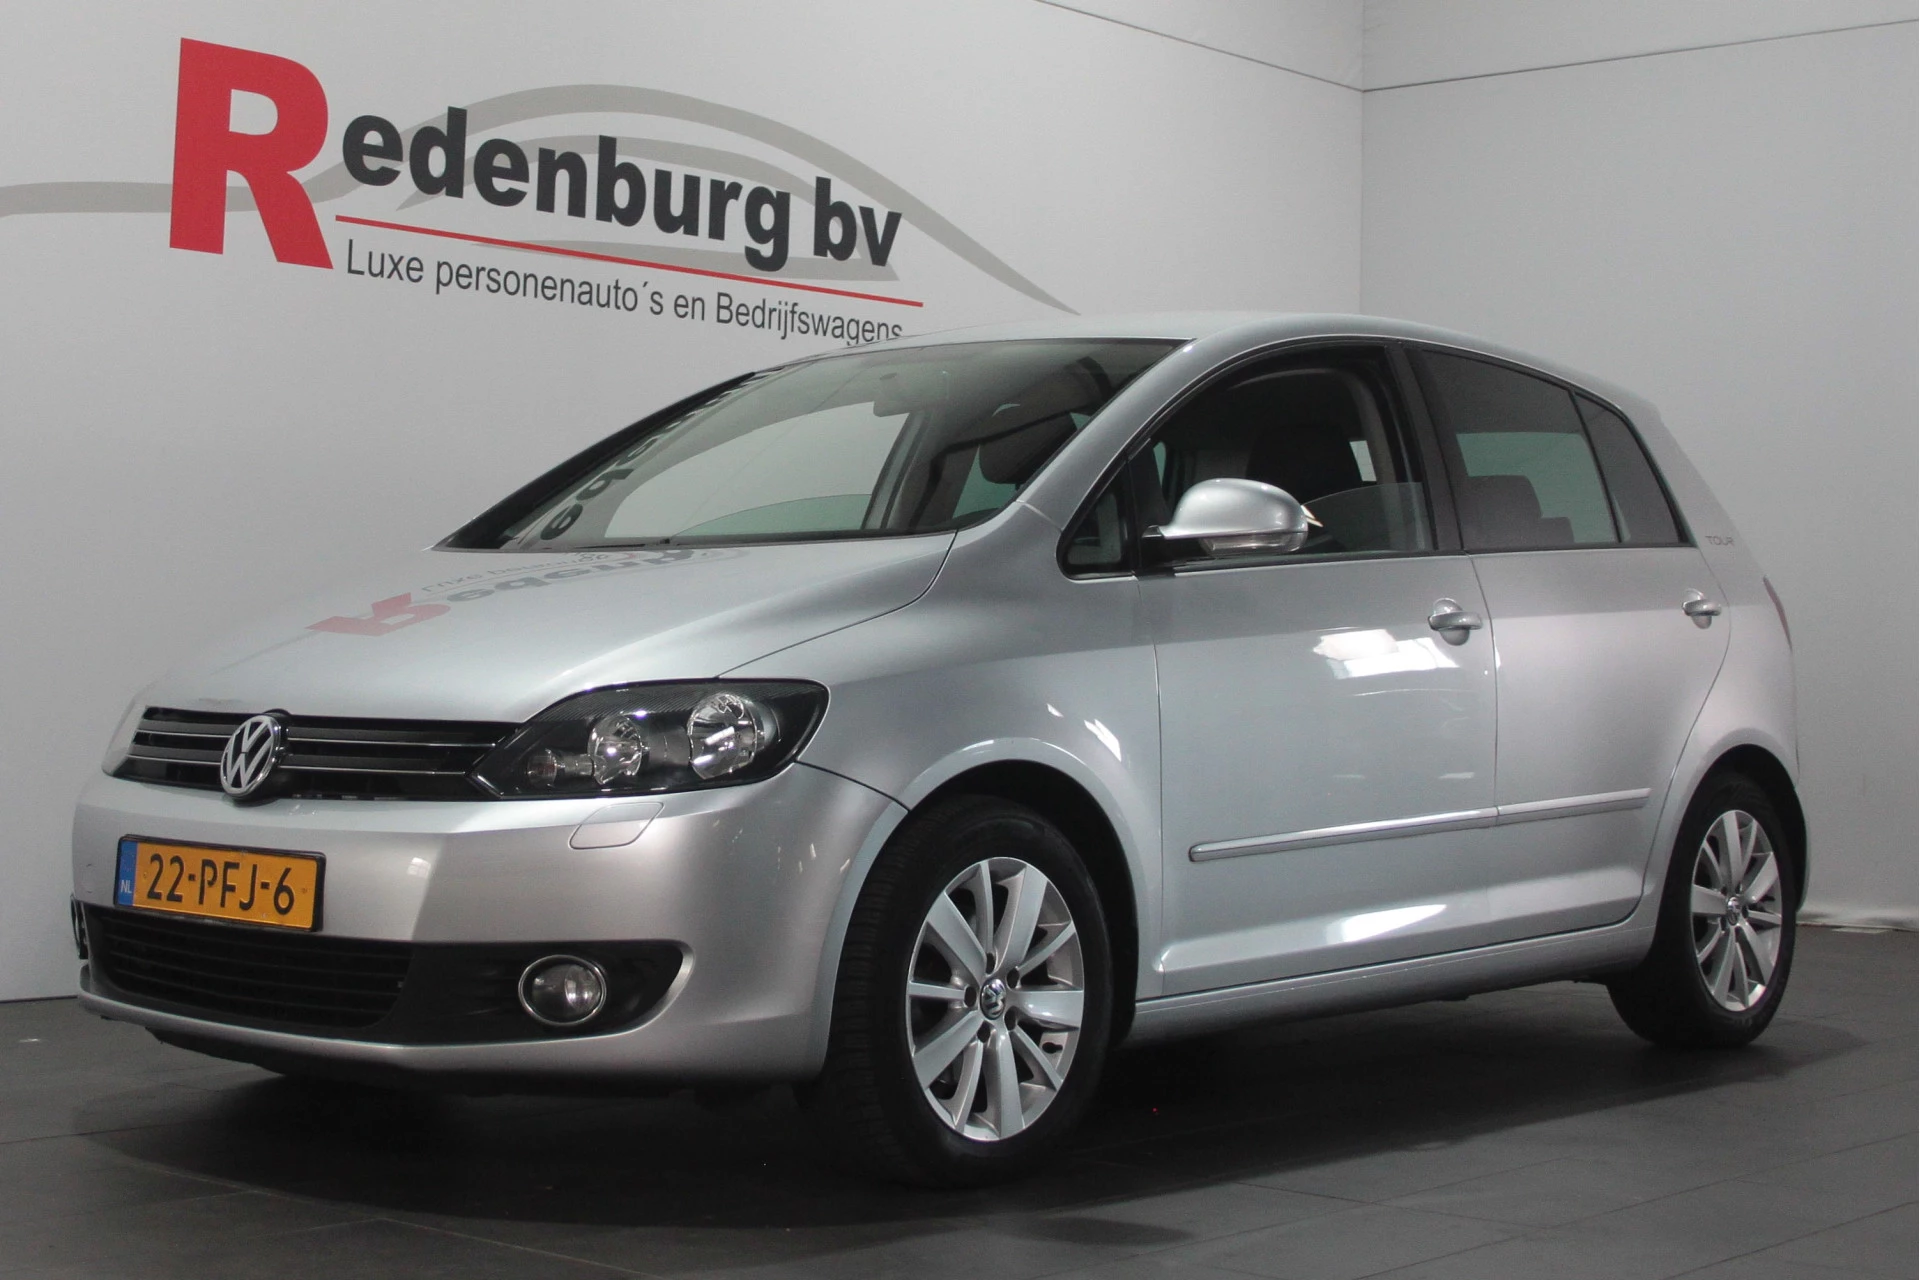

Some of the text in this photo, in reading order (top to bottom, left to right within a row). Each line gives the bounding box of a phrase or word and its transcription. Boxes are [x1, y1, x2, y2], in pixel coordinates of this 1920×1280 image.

[168, 37, 903, 273] Redenburg bv
[346, 238, 425, 284] Luxe
[673, 293, 706, 321] en
[221, 714, 278, 798] VW
[119, 879, 133, 895] NL
[146, 852, 296, 917] 22-PFJ-6
